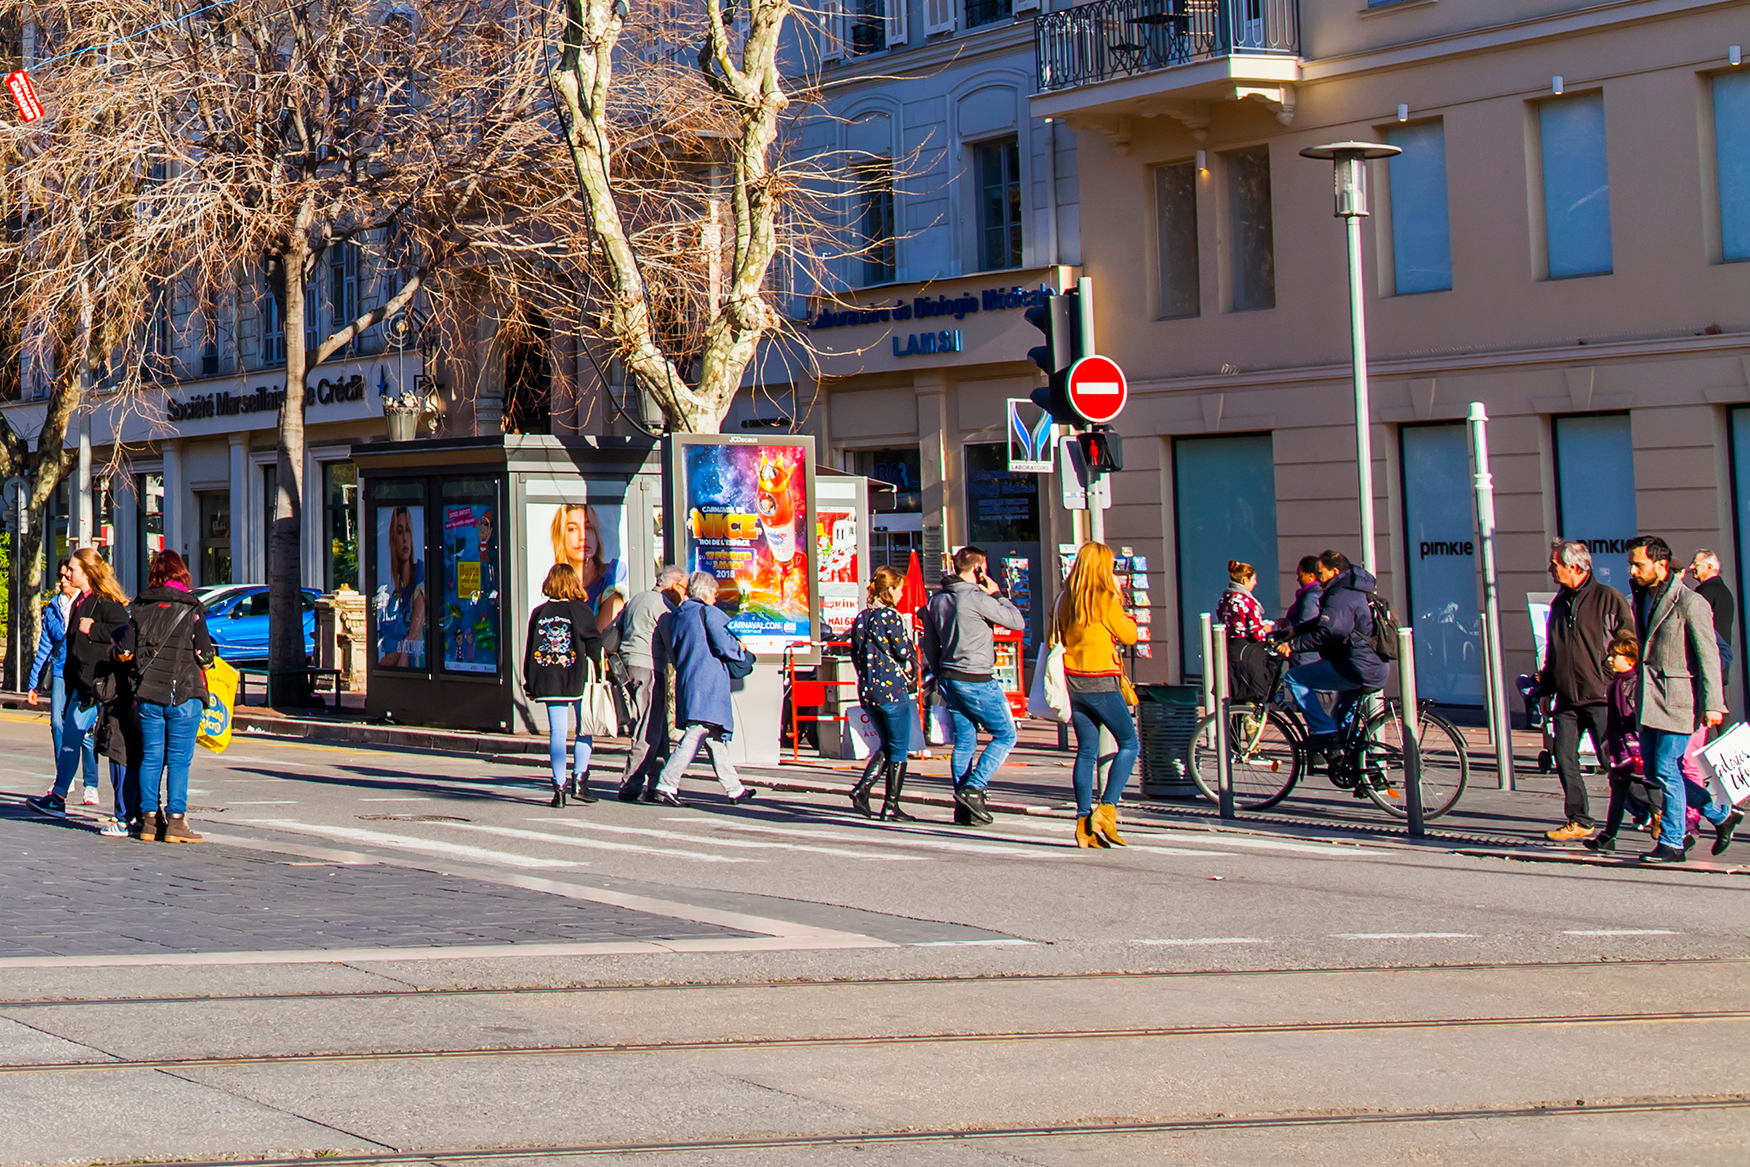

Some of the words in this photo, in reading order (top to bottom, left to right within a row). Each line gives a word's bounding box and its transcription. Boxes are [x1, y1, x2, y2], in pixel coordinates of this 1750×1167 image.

[10, 80, 35, 120] DANGER
[892, 298, 912, 321] de
[913, 291, 979, 320] Biologie
[166, 392, 215, 422] Société
[216, 385, 287, 416] Marseillais
[316, 374, 365, 405] Crédit
[729, 436, 758, 444] JCDecaux
[1010, 464, 1050, 472] LABORATOIRE
[693, 513, 758, 540] NICE
[1419, 539, 1474, 559] pimkie
[719, 561, 746, 570] MARS
[716, 570, 736, 579] 2018
[828, 617, 843, 626] MAI
